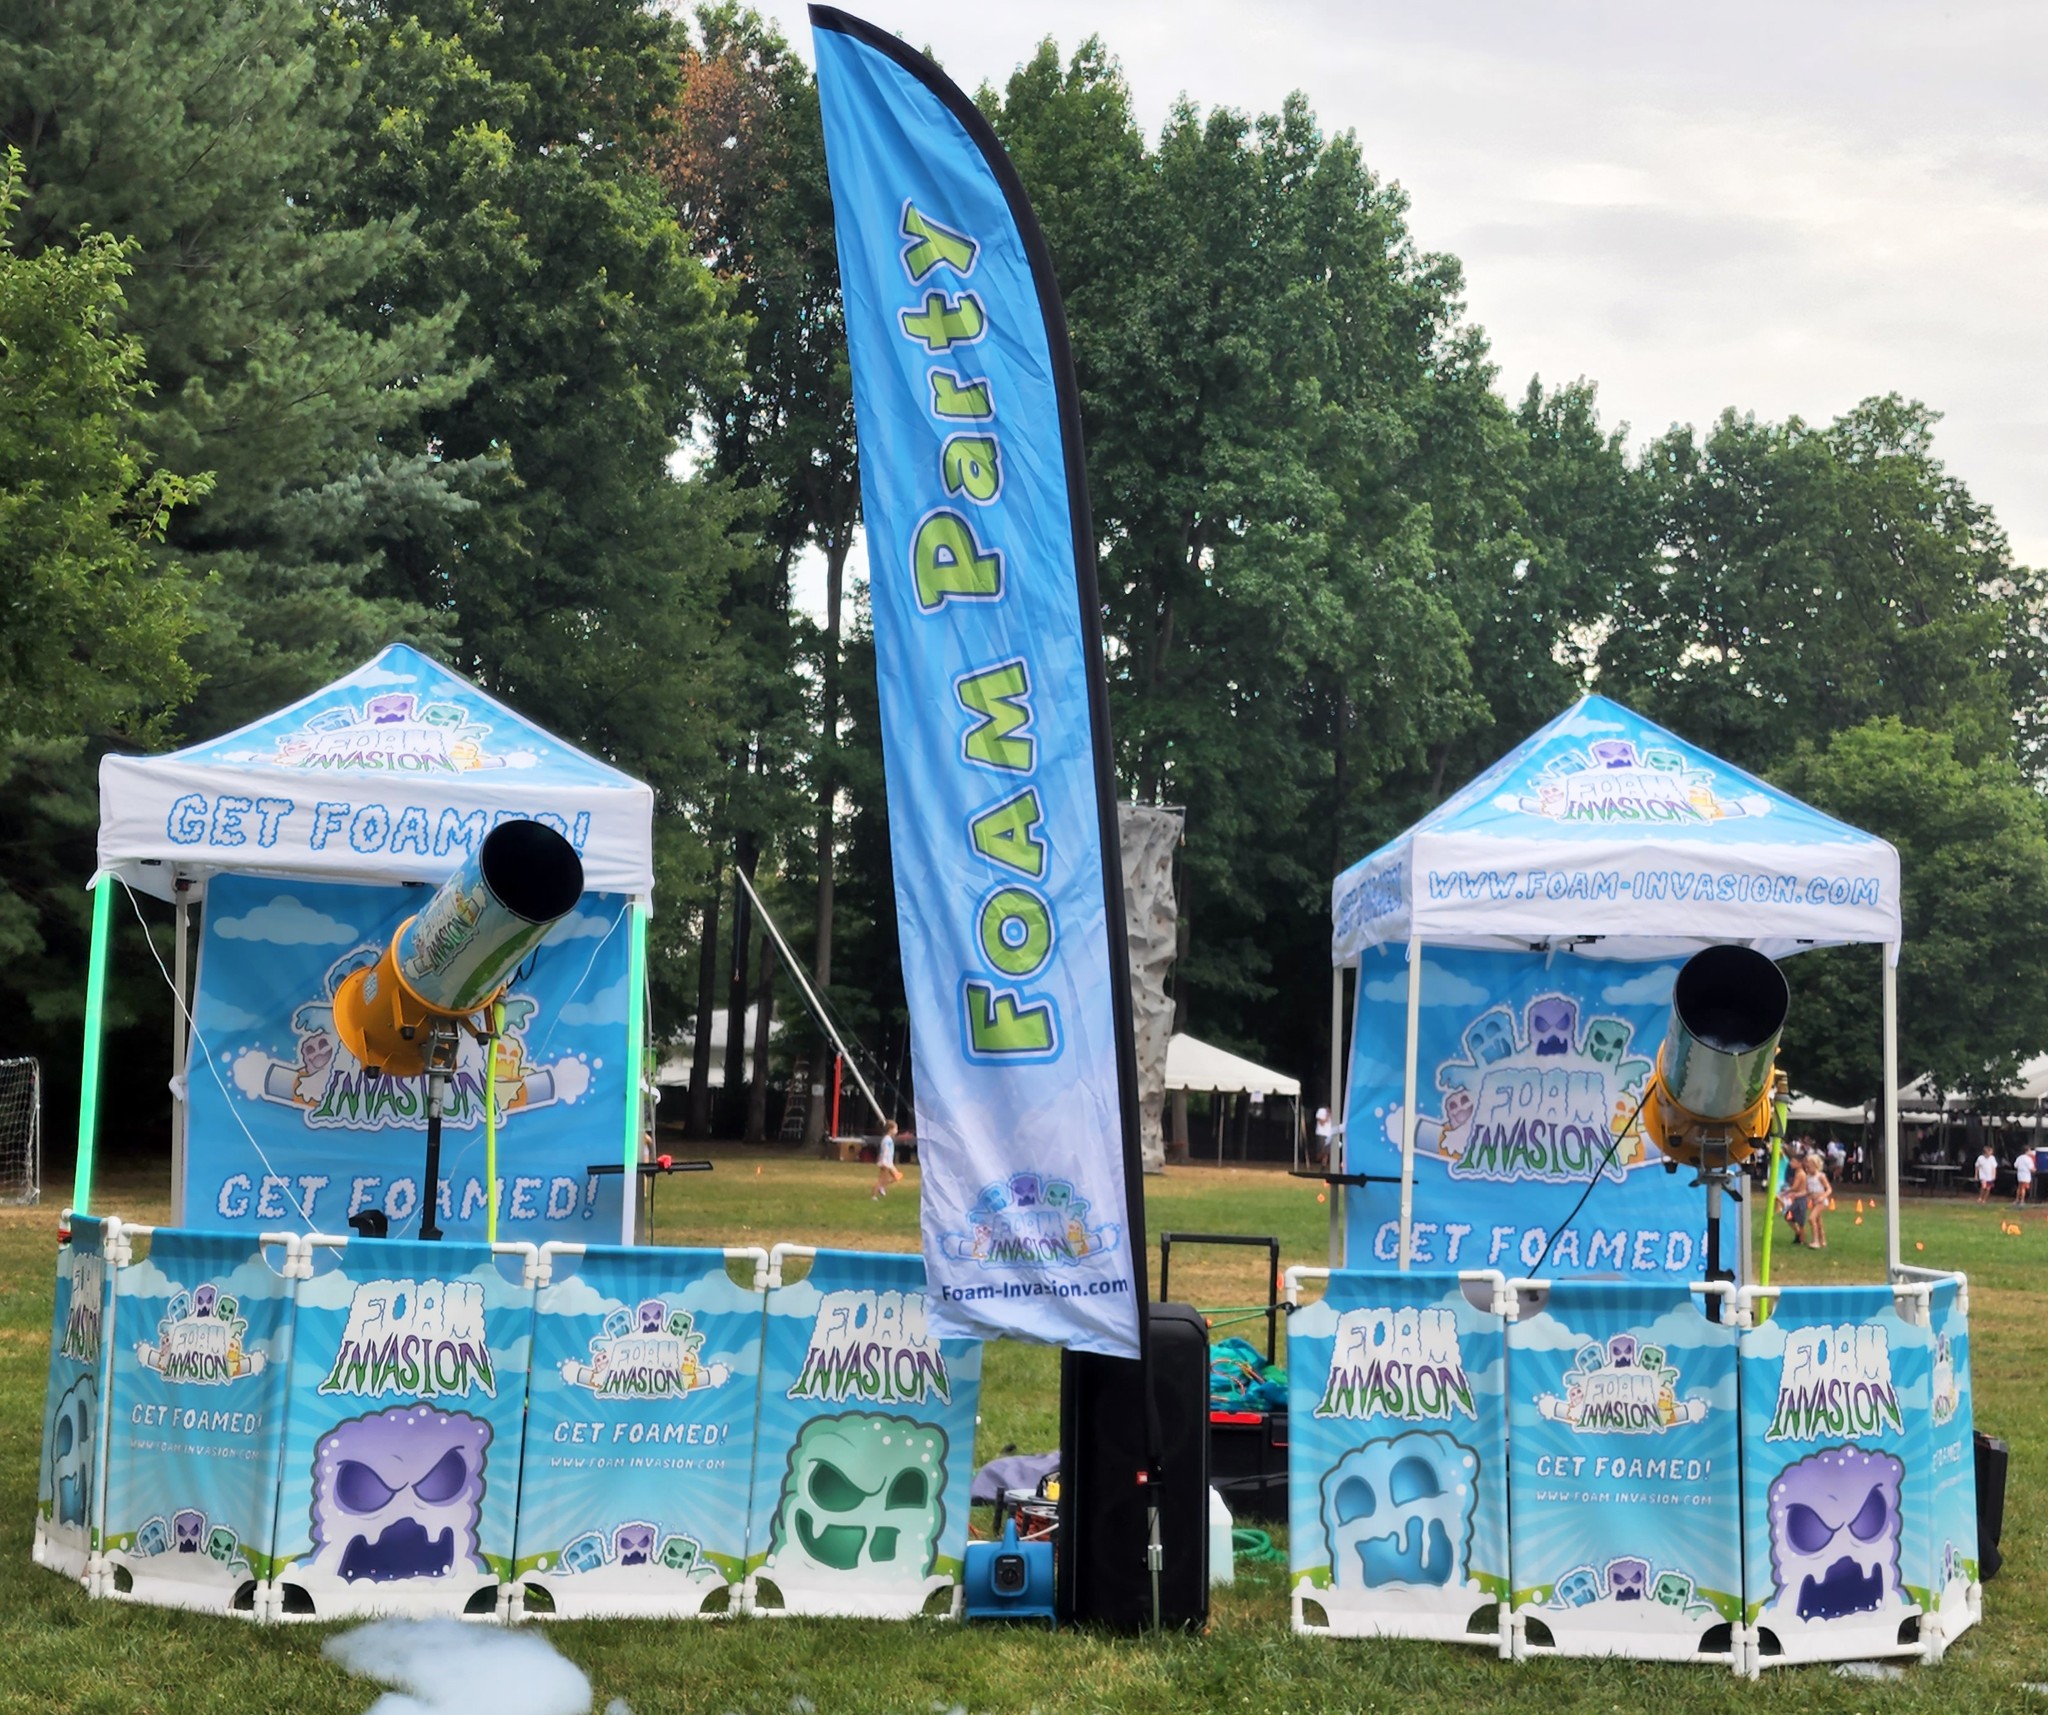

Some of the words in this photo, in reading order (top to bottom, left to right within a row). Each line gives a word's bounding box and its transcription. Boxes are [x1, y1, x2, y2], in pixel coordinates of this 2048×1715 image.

[318, 728, 444, 752] FOAM
[302, 751, 461, 773] INVASION
[1564, 774, 1687, 801] FOAM
[167, 793, 294, 848] GET
[310, 801, 590, 858] FOAM!
[1562, 798, 1706, 824] INVASION
[954, 655, 1056, 1058] FOAM
[1428, 870, 1880, 905] WWW.FOAM-INVASION.COM
[1477, 1067, 1607, 1123] FOAM
[1457, 1117, 1621, 1173] INVASION
[216, 1173, 330, 1220] GET
[988, 1236, 1076, 1263] INVASION
[1373, 1219, 1472, 1264] GET
[1488, 1225, 1708, 1273] FOAMED!
[942, 1278, 1128, 1302] Foam-Invasion.com
[343, 1278, 485, 1340] FOAM
[171, 1323, 226, 1353] FOAM
[1331, 1306, 1462, 1364] FOAM
[164, 1350, 230, 1380] INVASION
[322, 1332, 493, 1394] INVASION
[608, 1339, 680, 1368] FOAM
[1780, 1323, 1892, 1381] FOAM
[599, 1366, 686, 1395] INVASION
[790, 1340, 949, 1401] INVASION
[1316, 1358, 1474, 1417] INVASION
[1586, 1373, 1658, 1403] FOAM
[132, 1403, 168, 1425] GET
[172, 1408, 262, 1435] FOAMED!
[1577, 1400, 1666, 1430] INVASION
[1767, 1377, 1901, 1438] INVASION
[553, 1421, 605, 1443] GET
[612, 1423, 729, 1446] FOAMED!
[1536, 1455, 1586, 1477] GET
[1594, 1457, 1712, 1481] FOAMED!
